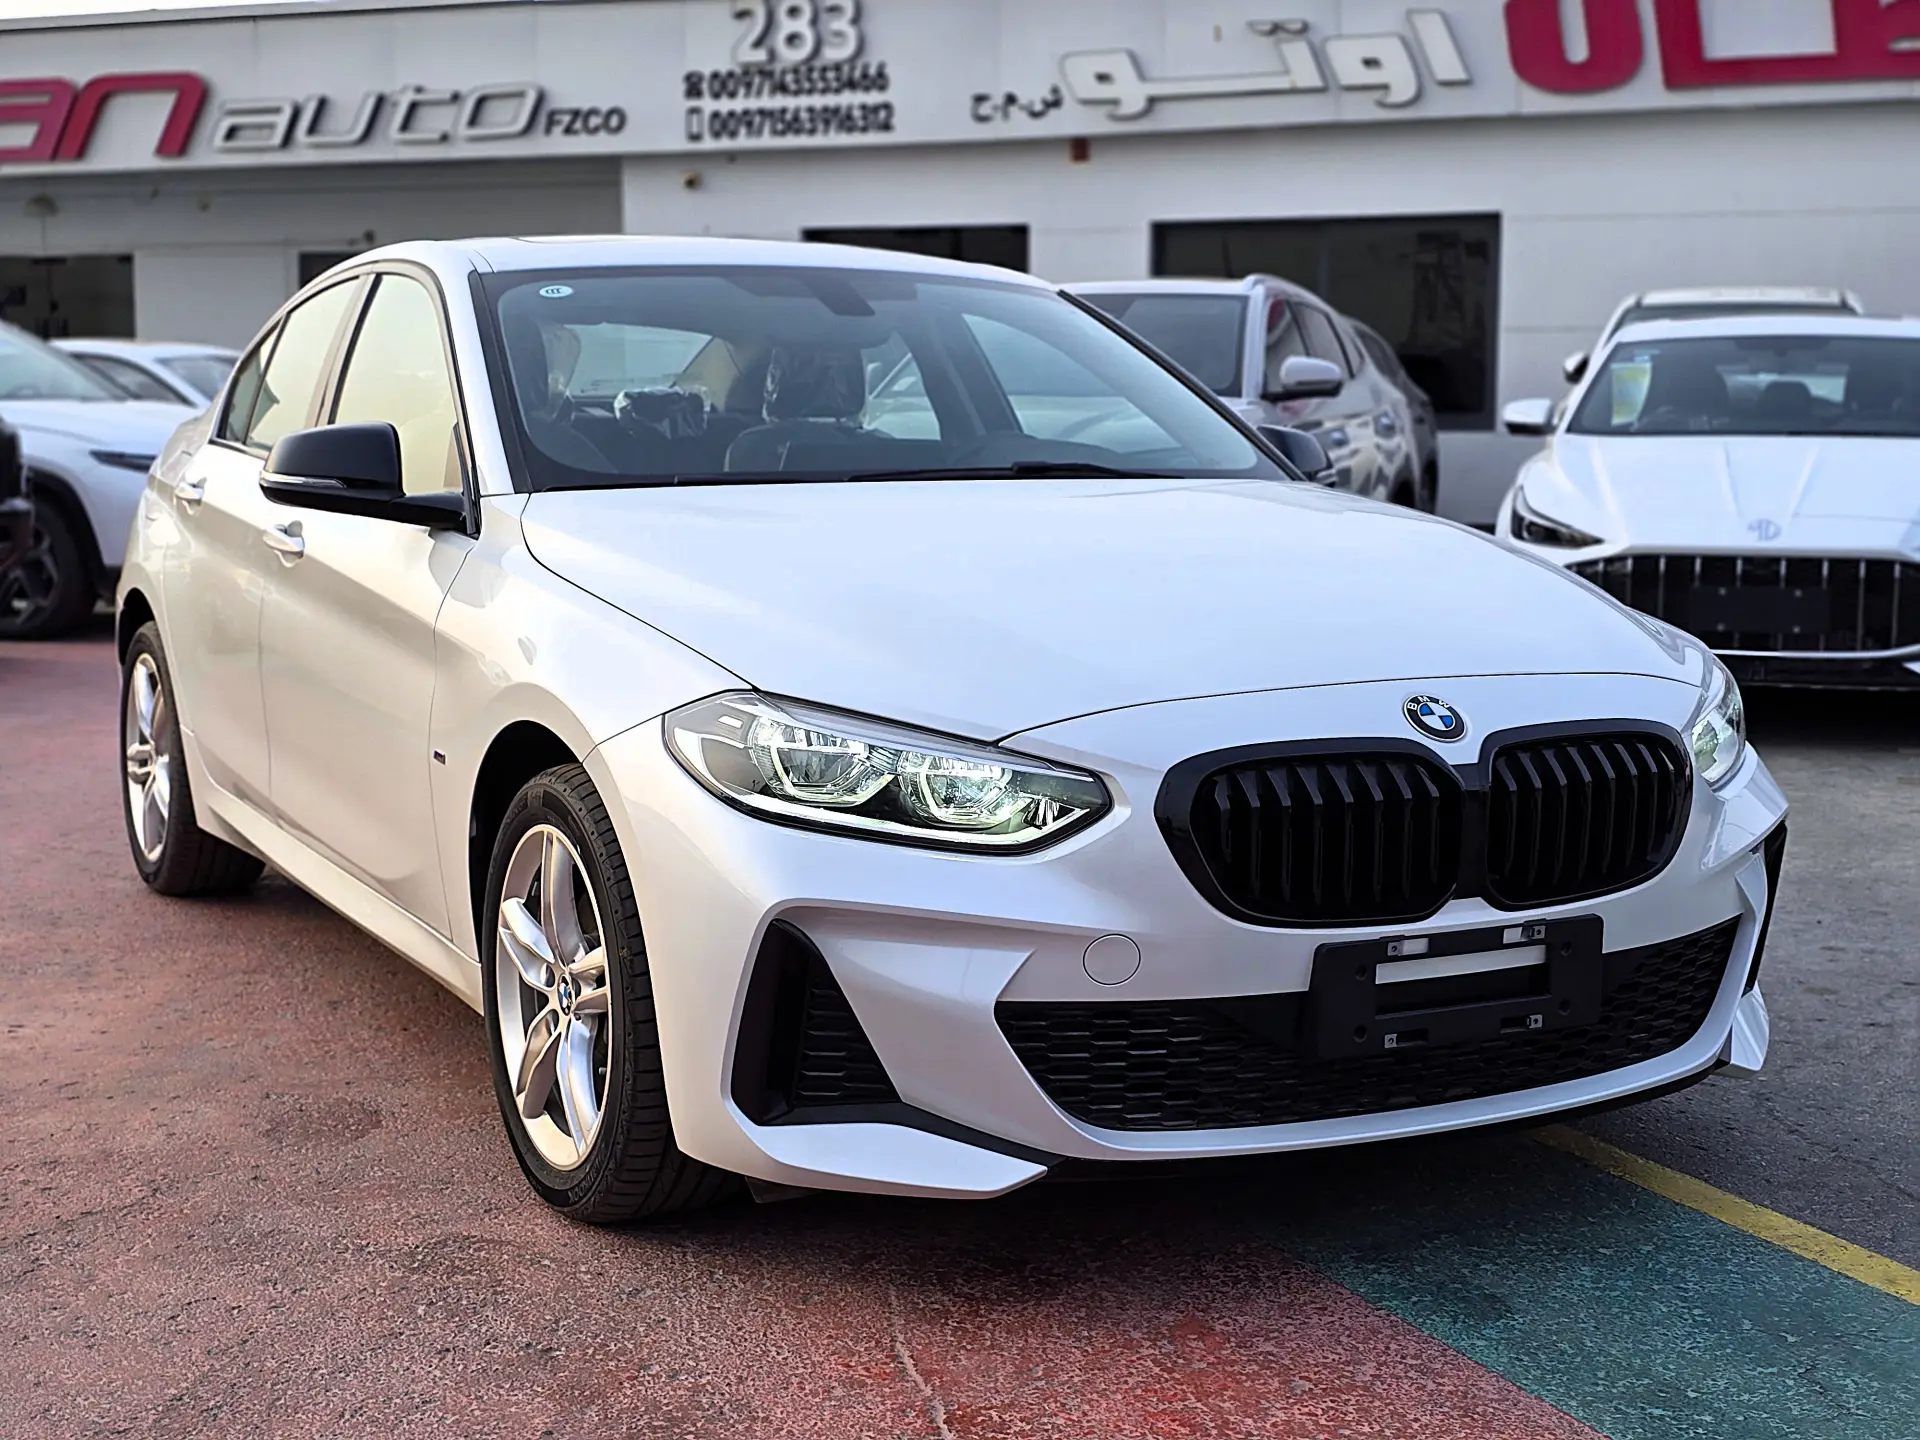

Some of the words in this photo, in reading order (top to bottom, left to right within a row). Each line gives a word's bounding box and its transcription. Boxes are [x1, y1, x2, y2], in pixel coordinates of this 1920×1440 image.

[731, 0, 866, 65] 283
[213, 83, 546, 153] auto
[544, 106, 628, 137] FZCO
